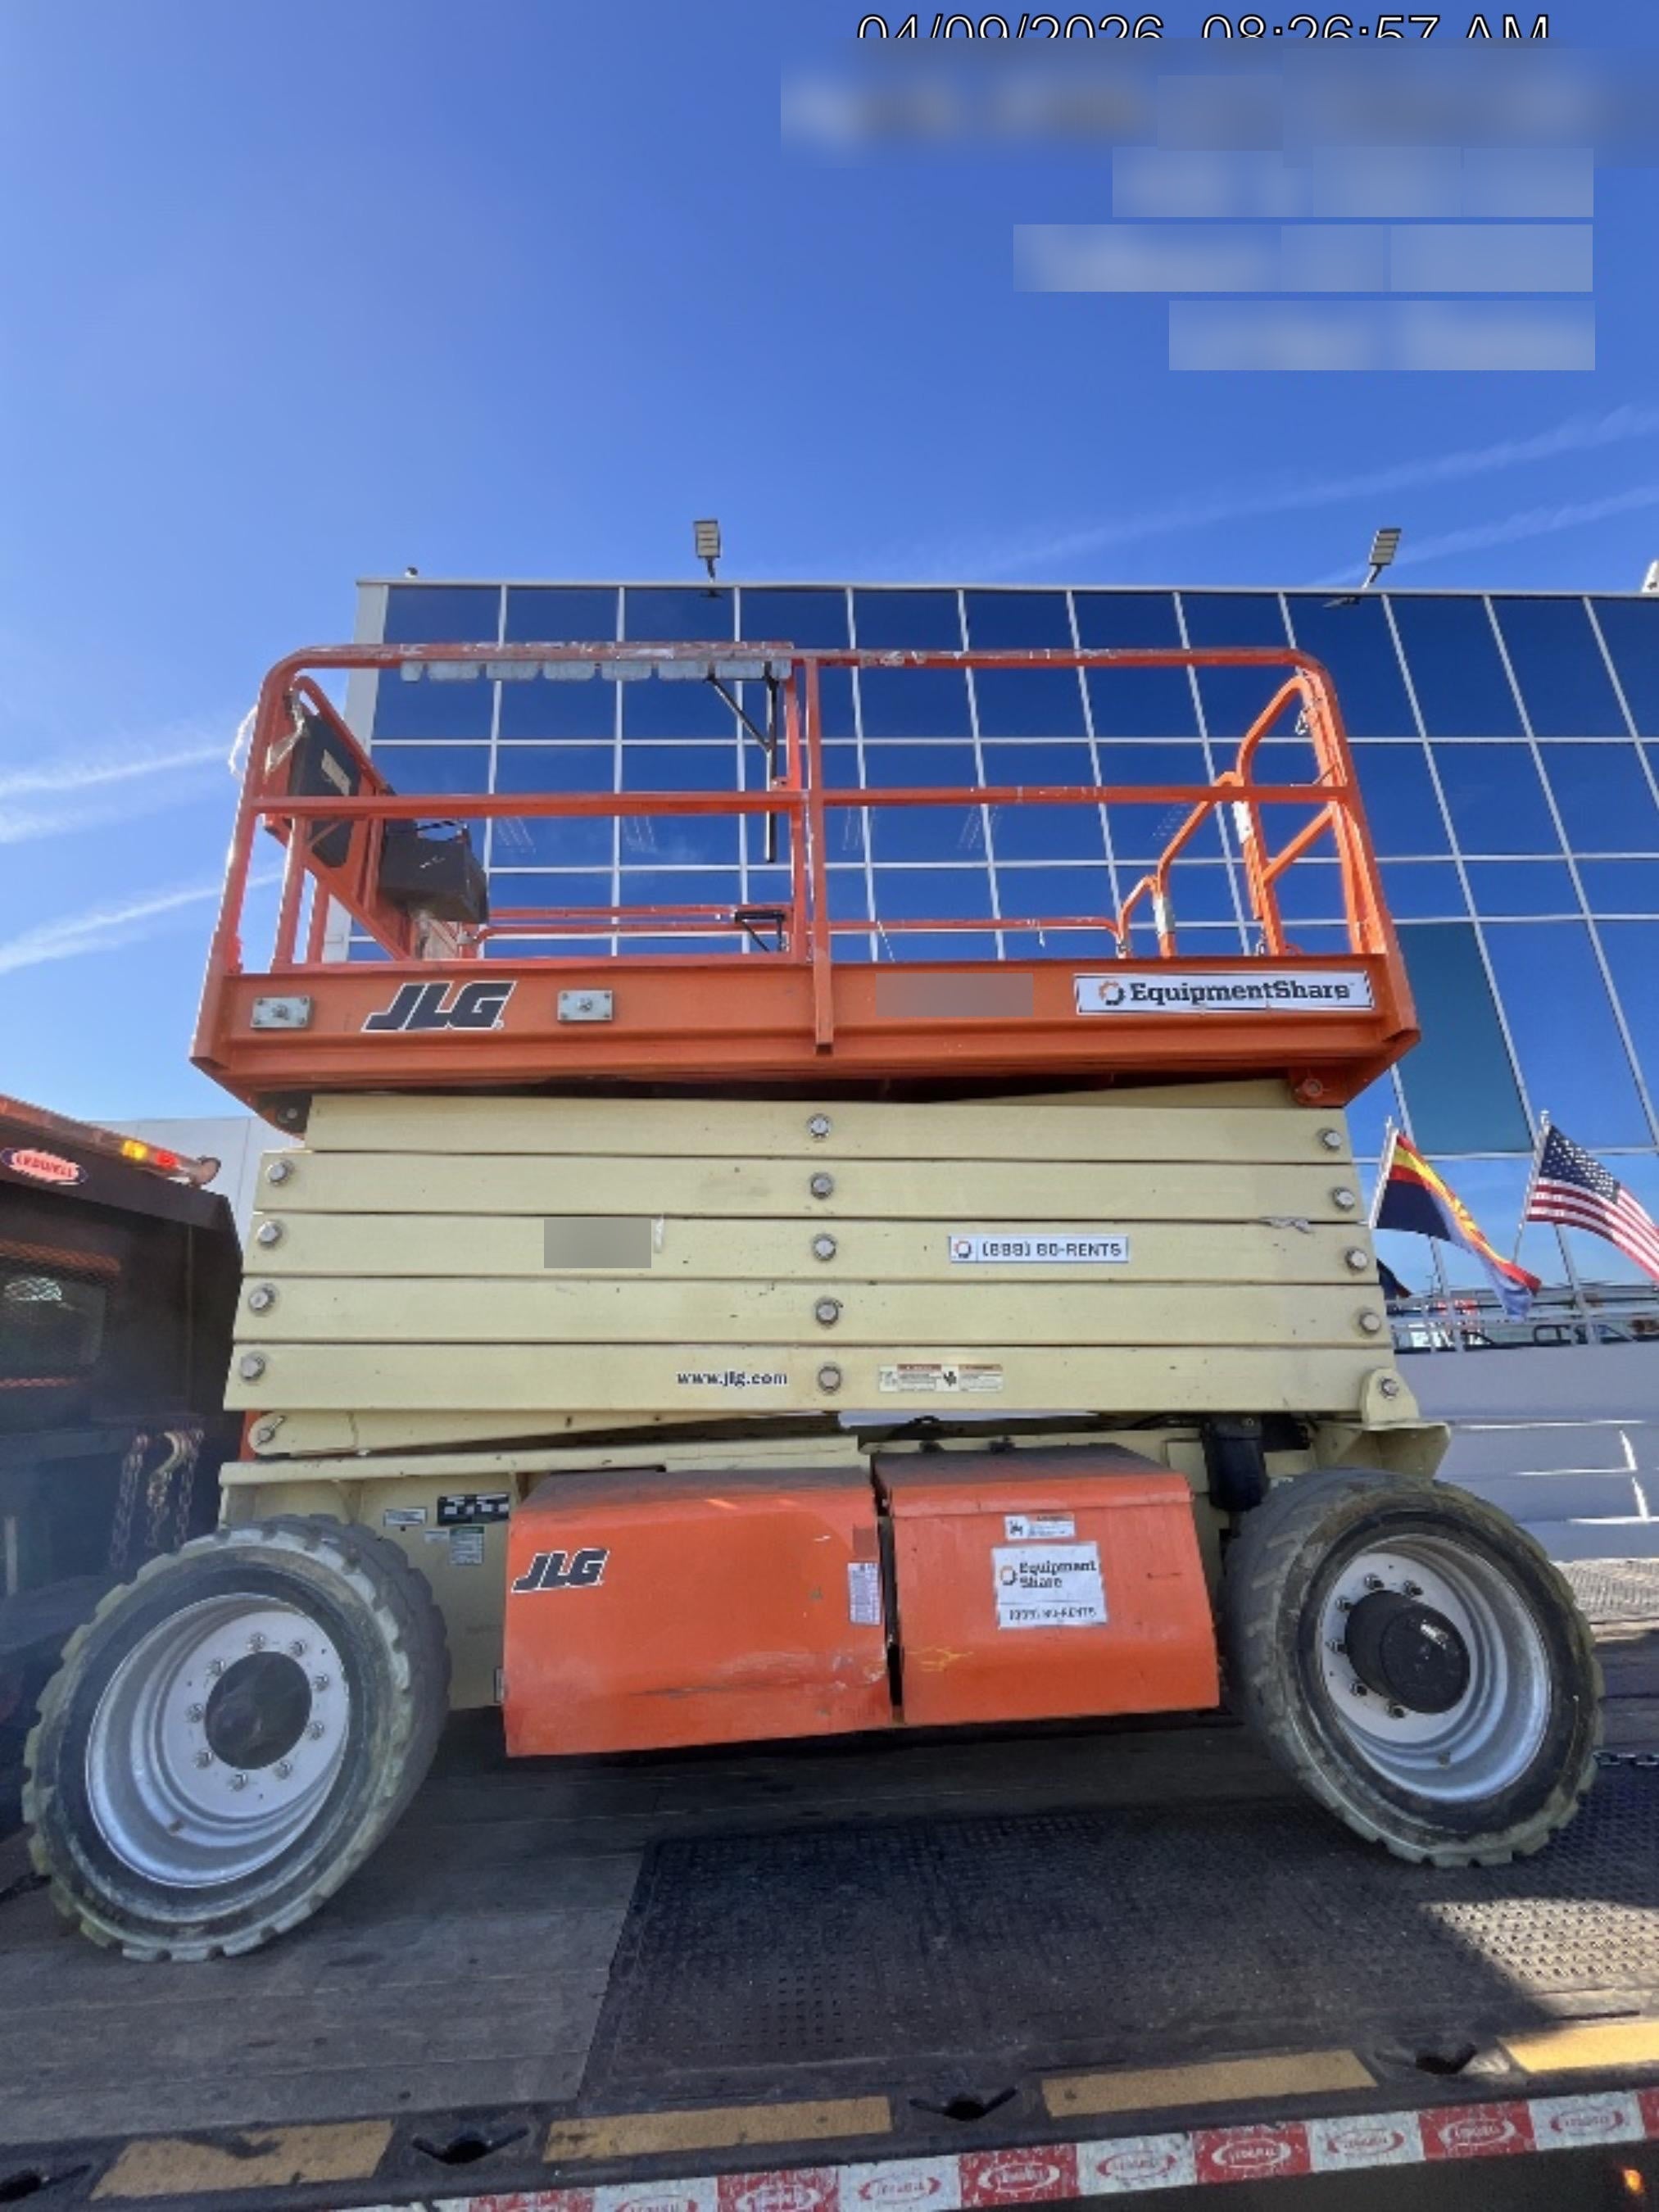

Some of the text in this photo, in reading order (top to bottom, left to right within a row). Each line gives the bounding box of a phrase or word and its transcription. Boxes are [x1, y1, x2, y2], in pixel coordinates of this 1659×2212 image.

[1130, 980, 1351, 1005] EquipmentShare
[361, 981, 518, 1031] JLG
[677, 1371, 787, 1387] www.jlg.com
[511, 1548, 610, 1593] JLG
[1019, 1560, 1097, 1576] Equipment
